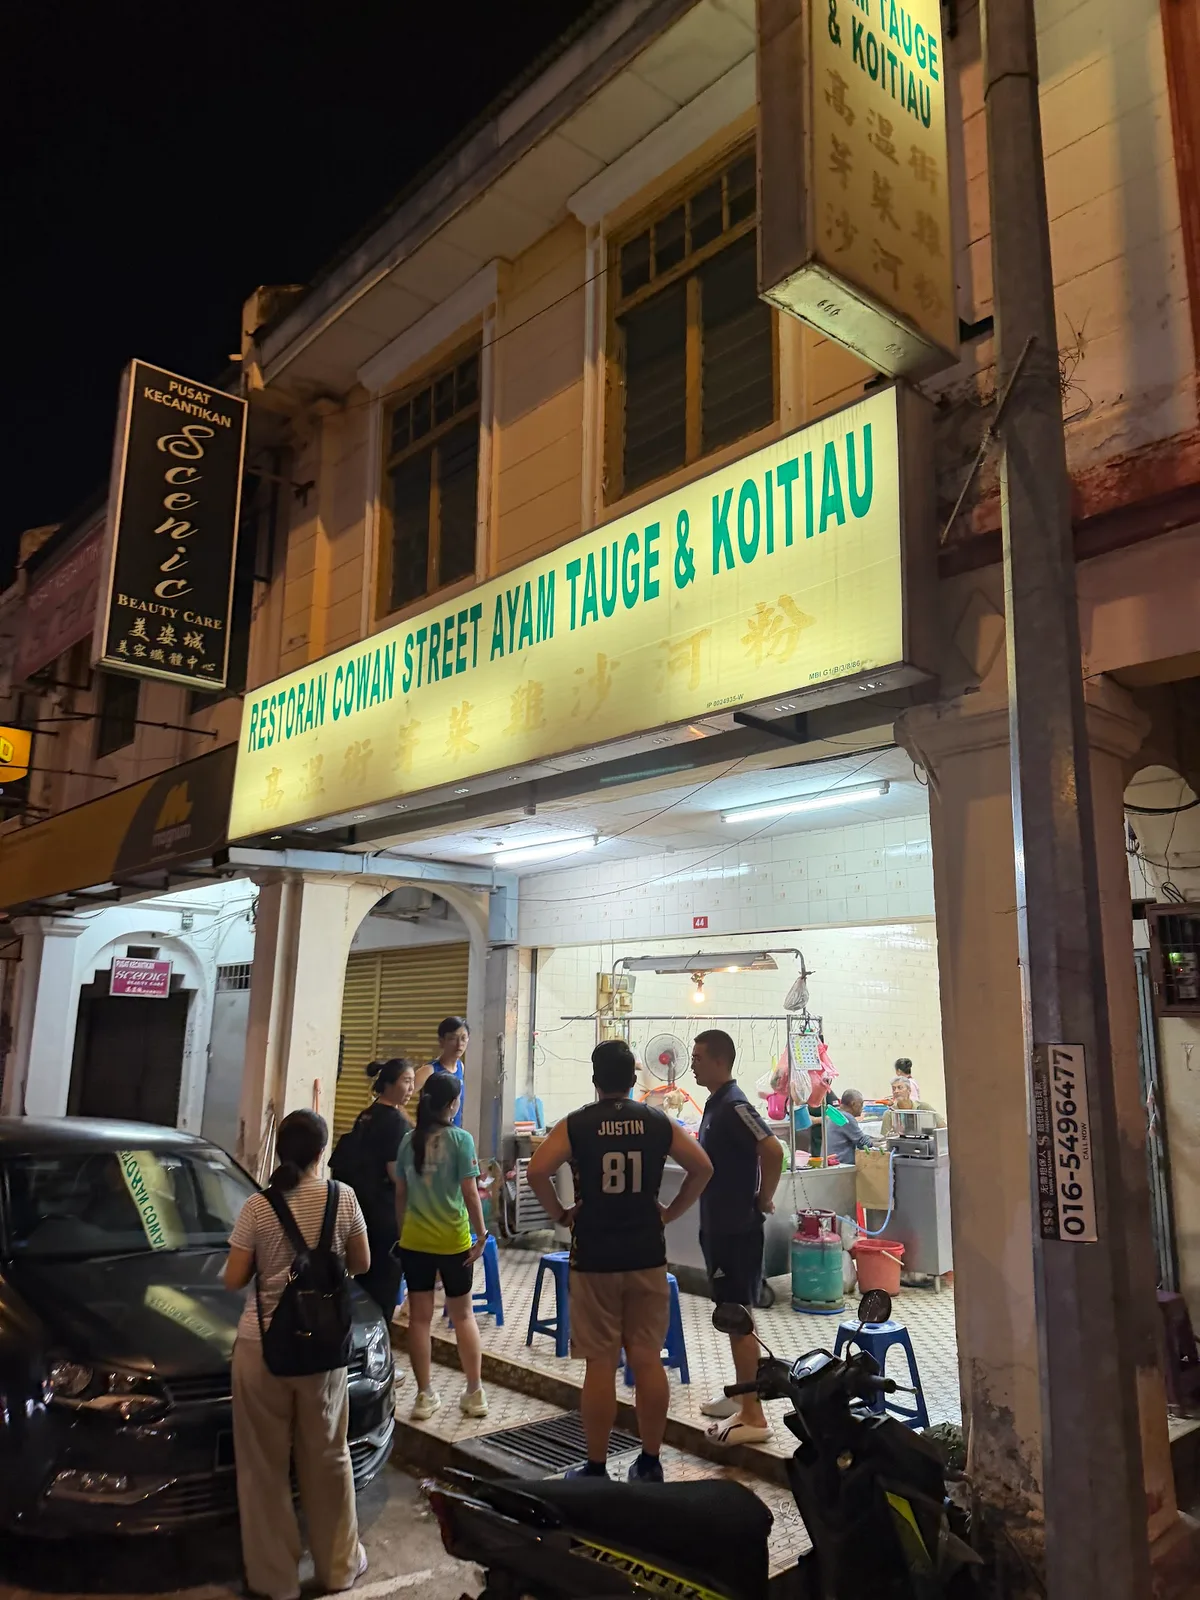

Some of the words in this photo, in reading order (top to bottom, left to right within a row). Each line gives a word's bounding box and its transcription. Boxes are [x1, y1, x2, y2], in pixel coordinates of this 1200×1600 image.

[828, 0, 841, 48] &
[852, 14, 931, 129] KOITIAU
[144, 387, 231, 428] KECANTIKAN
[169, 380, 212, 404] PUSAT
[155, 424, 215, 599] Scenic
[247, 672, 328, 754] RESTORAN
[332, 641, 397, 721] COWAN
[402, 603, 482, 694] STREET
[490, 569, 555, 662] AYAM
[566, 521, 661, 631] TAUGE
[674, 509, 696, 590] &
[712, 423, 873, 576] KOITIAU
[117, 593, 179, 618] BEAUTY
[183, 611, 223, 629] CARE
[695, 918, 705, 927] 44
[598, 1120, 644, 1136] JUSTIN
[1053, 1049, 1086, 1236] 016-5496477
[1082, 1142, 1090, 1160] CALL
[602, 1151, 643, 1194] 81
